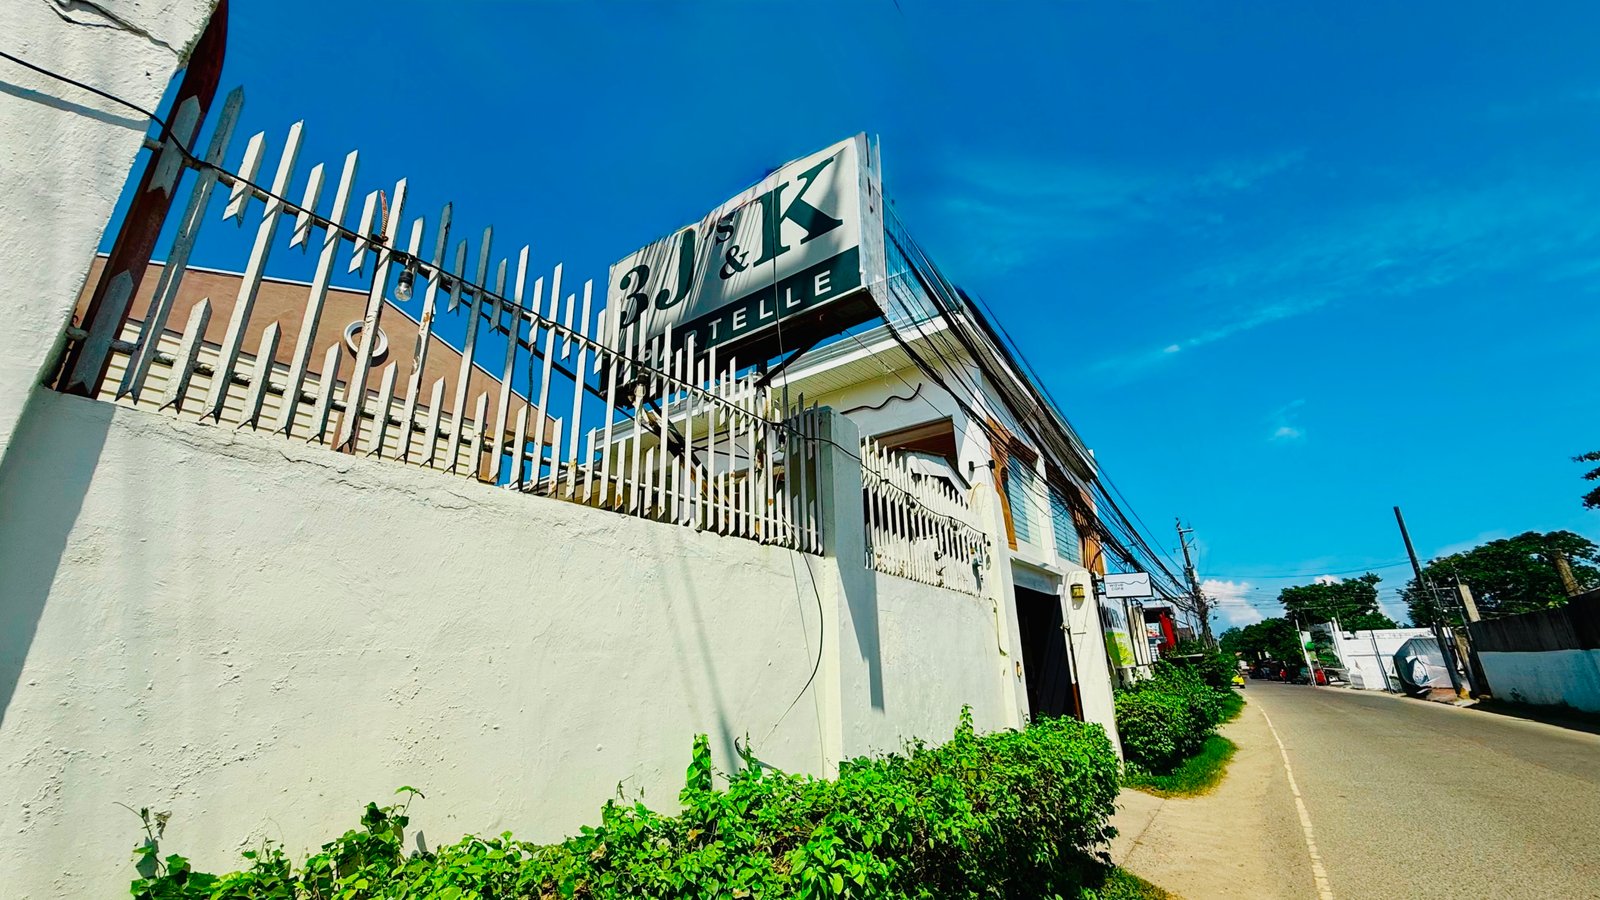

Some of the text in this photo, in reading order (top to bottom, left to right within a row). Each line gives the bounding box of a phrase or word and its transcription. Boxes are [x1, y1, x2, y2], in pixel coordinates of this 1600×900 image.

[719, 245, 749, 280] &
[753, 156, 844, 268] K
[618, 269, 832, 379] PARTELLE
